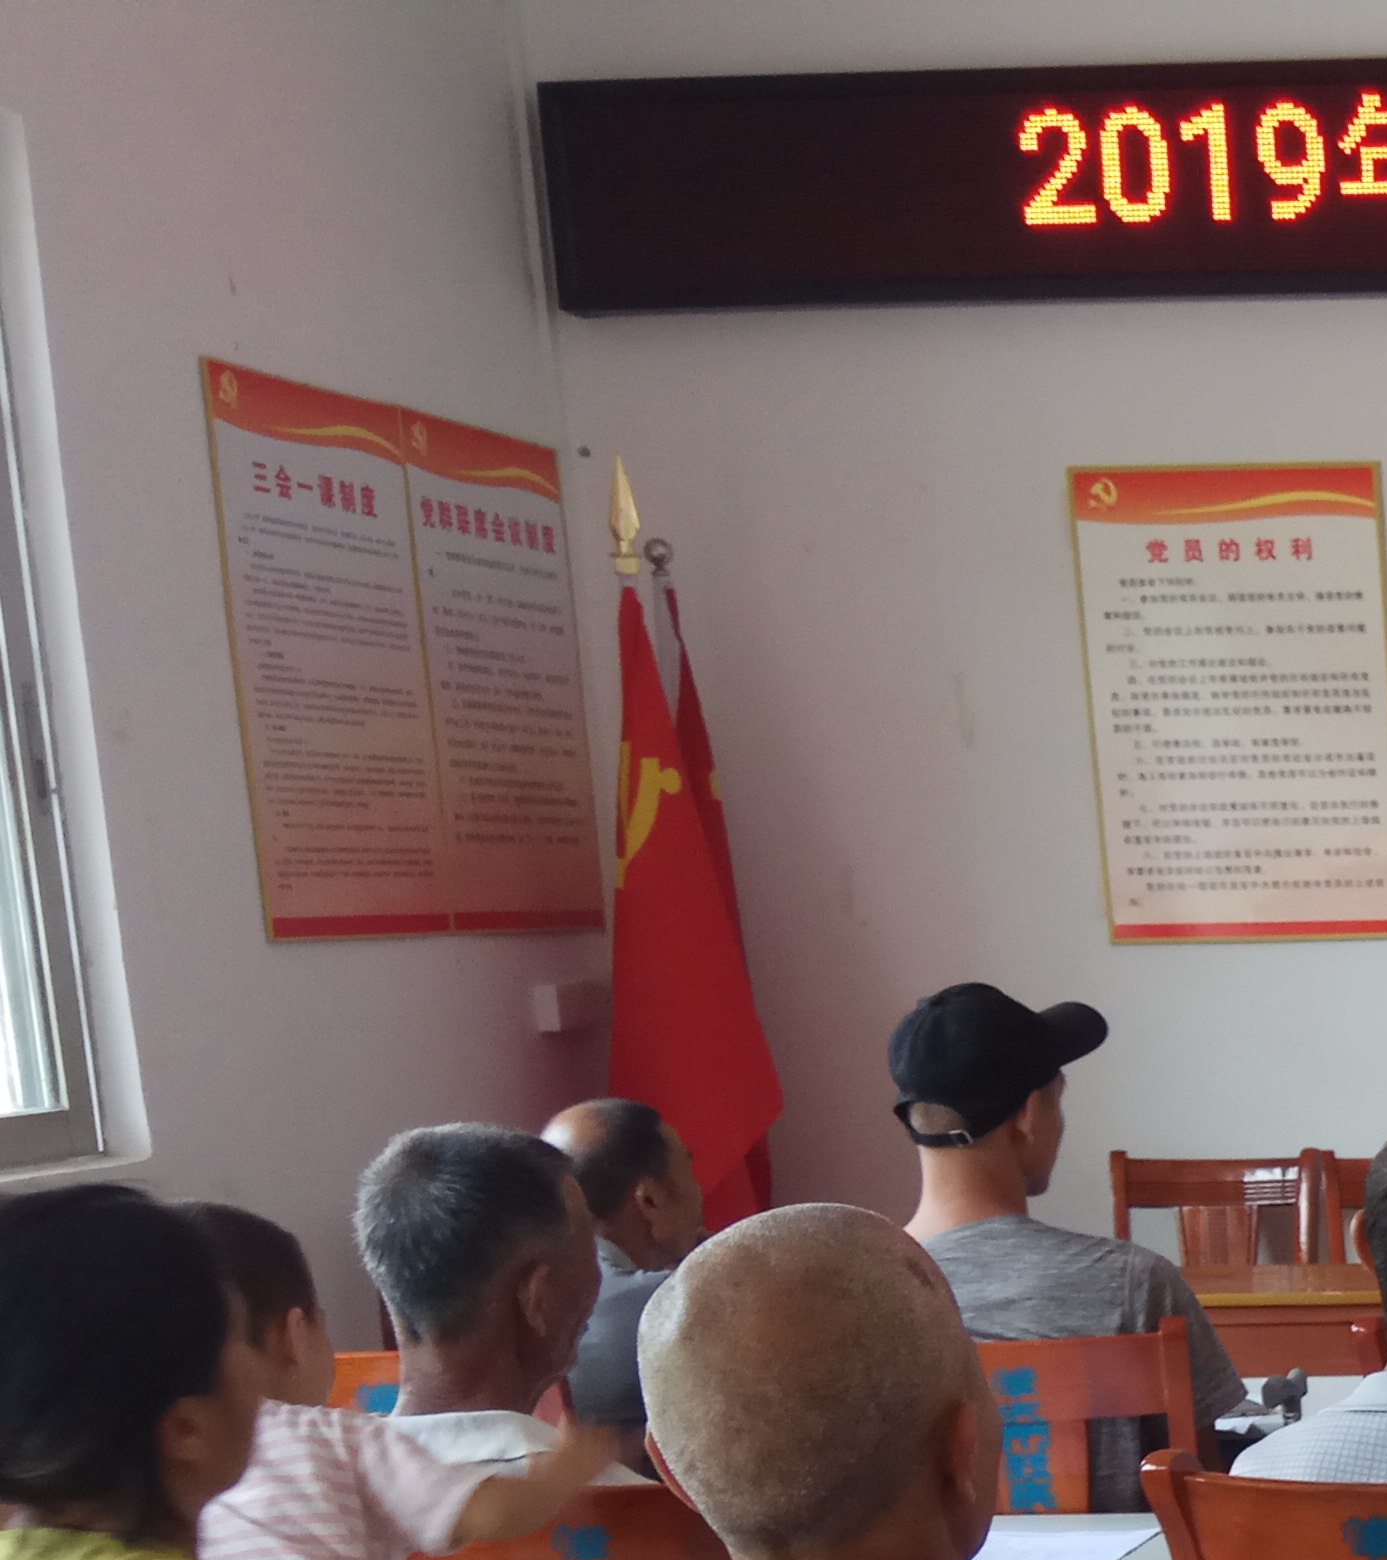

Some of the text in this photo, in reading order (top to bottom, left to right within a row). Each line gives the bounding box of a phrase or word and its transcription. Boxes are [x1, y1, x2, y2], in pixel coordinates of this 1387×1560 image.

[252, 461, 378, 518] 三会一课制度
[1145, 537, 1314, 564] 党员的权利
